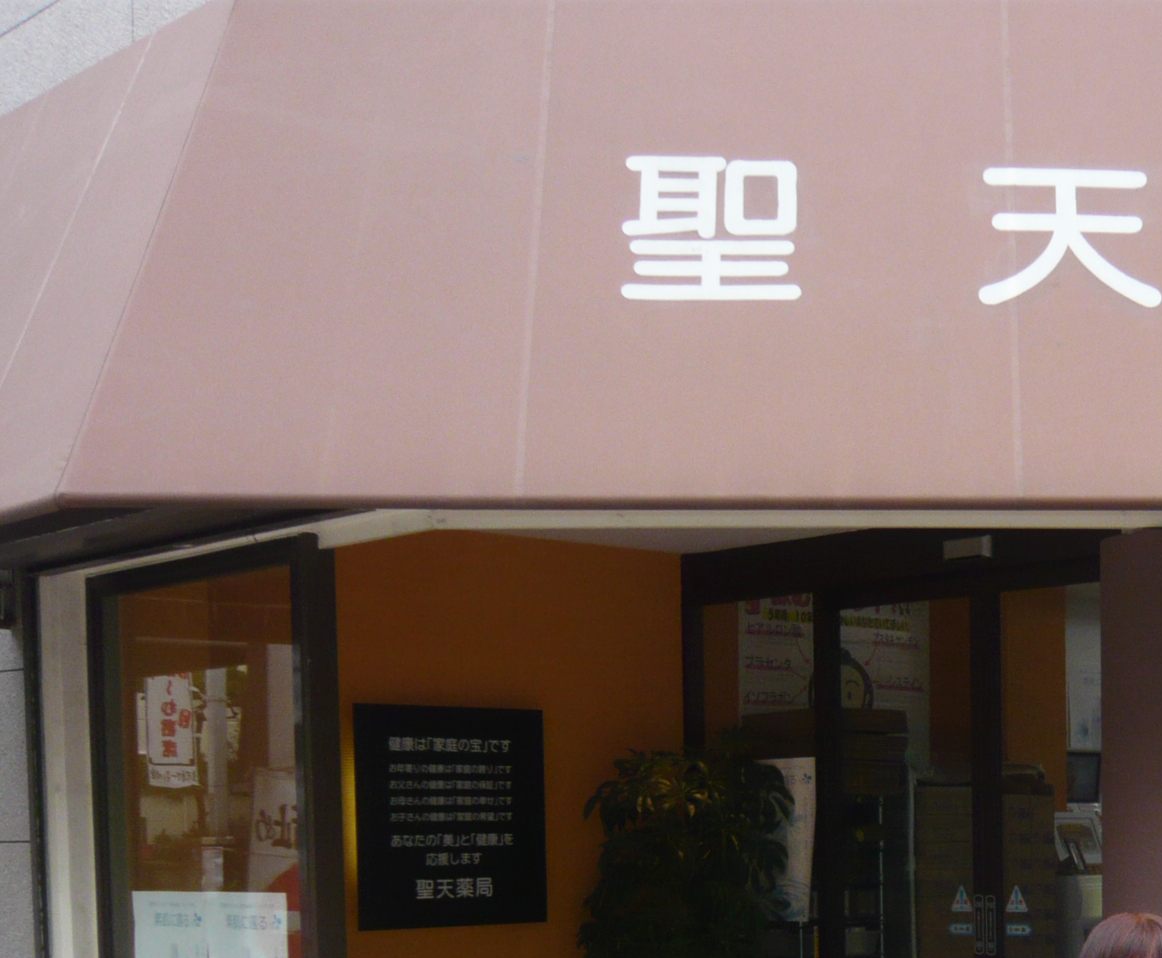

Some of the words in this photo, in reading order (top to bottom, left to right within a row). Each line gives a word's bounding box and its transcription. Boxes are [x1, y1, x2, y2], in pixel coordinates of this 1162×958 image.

[388, 736, 512, 753] 健康は「家庭の宝」です
[390, 833, 514, 847] あなたの「美」と「健康」を
[425, 852, 483, 866] 応援します
[415, 877, 493, 900] 聖天薬局
